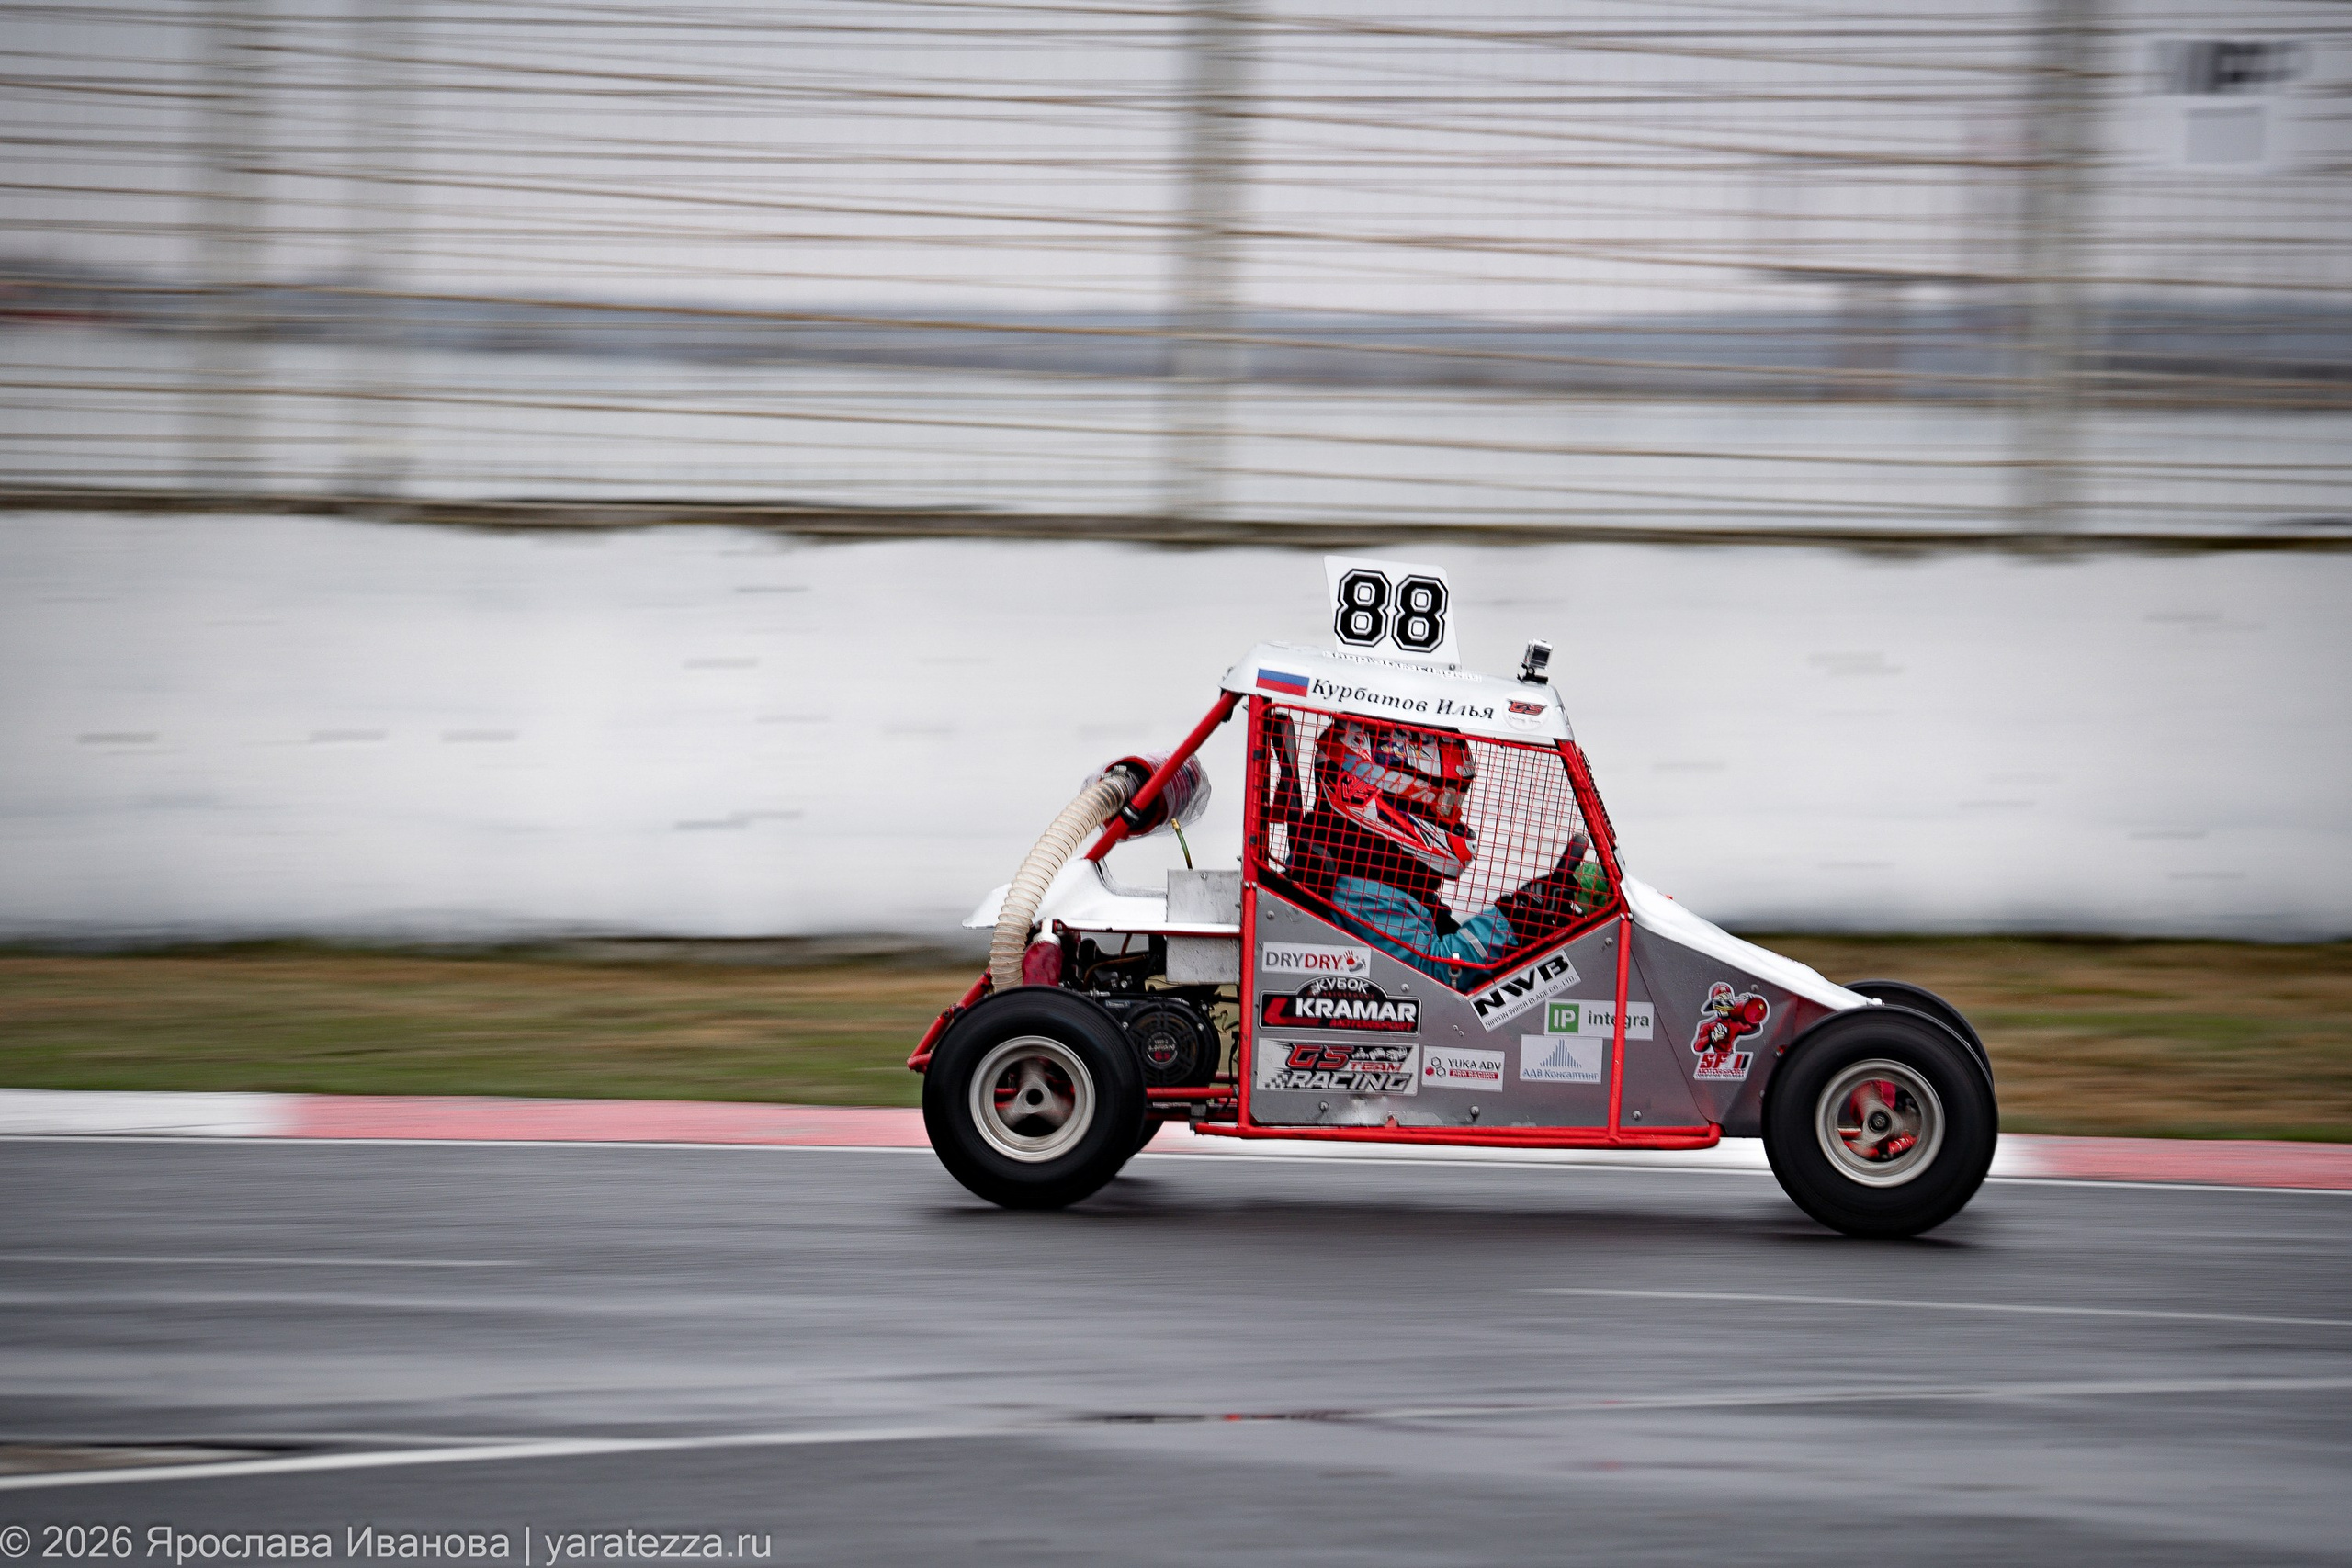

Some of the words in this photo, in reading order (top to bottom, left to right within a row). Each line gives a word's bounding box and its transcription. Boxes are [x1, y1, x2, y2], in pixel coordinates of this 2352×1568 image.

[1334, 568, 1449, 653] 88
[1312, 678, 1428, 712] Курбатов
[1436, 698, 1494, 719] Илья
[1266, 951, 1342, 970] DRYDRY
[1473, 955, 1569, 1018] NWB
[1295, 998, 1417, 1022] KRAMAR
[1485, 1012, 1509, 1028] NIPPON
[1510, 1000, 1529, 1016] WIPER
[1528, 989, 1549, 1004] BLADE
[1554, 1008, 1577, 1029] IP
[1286, 1043, 1354, 1070] GS
[1350, 1061, 1406, 1073] TEAM
[1448, 1057, 1477, 1070] YUKA
[1479, 1060, 1501, 1072] ADV
[1286, 1071, 1412, 1091] RACING
[1544, 1069, 1599, 1080] Консалтинг
